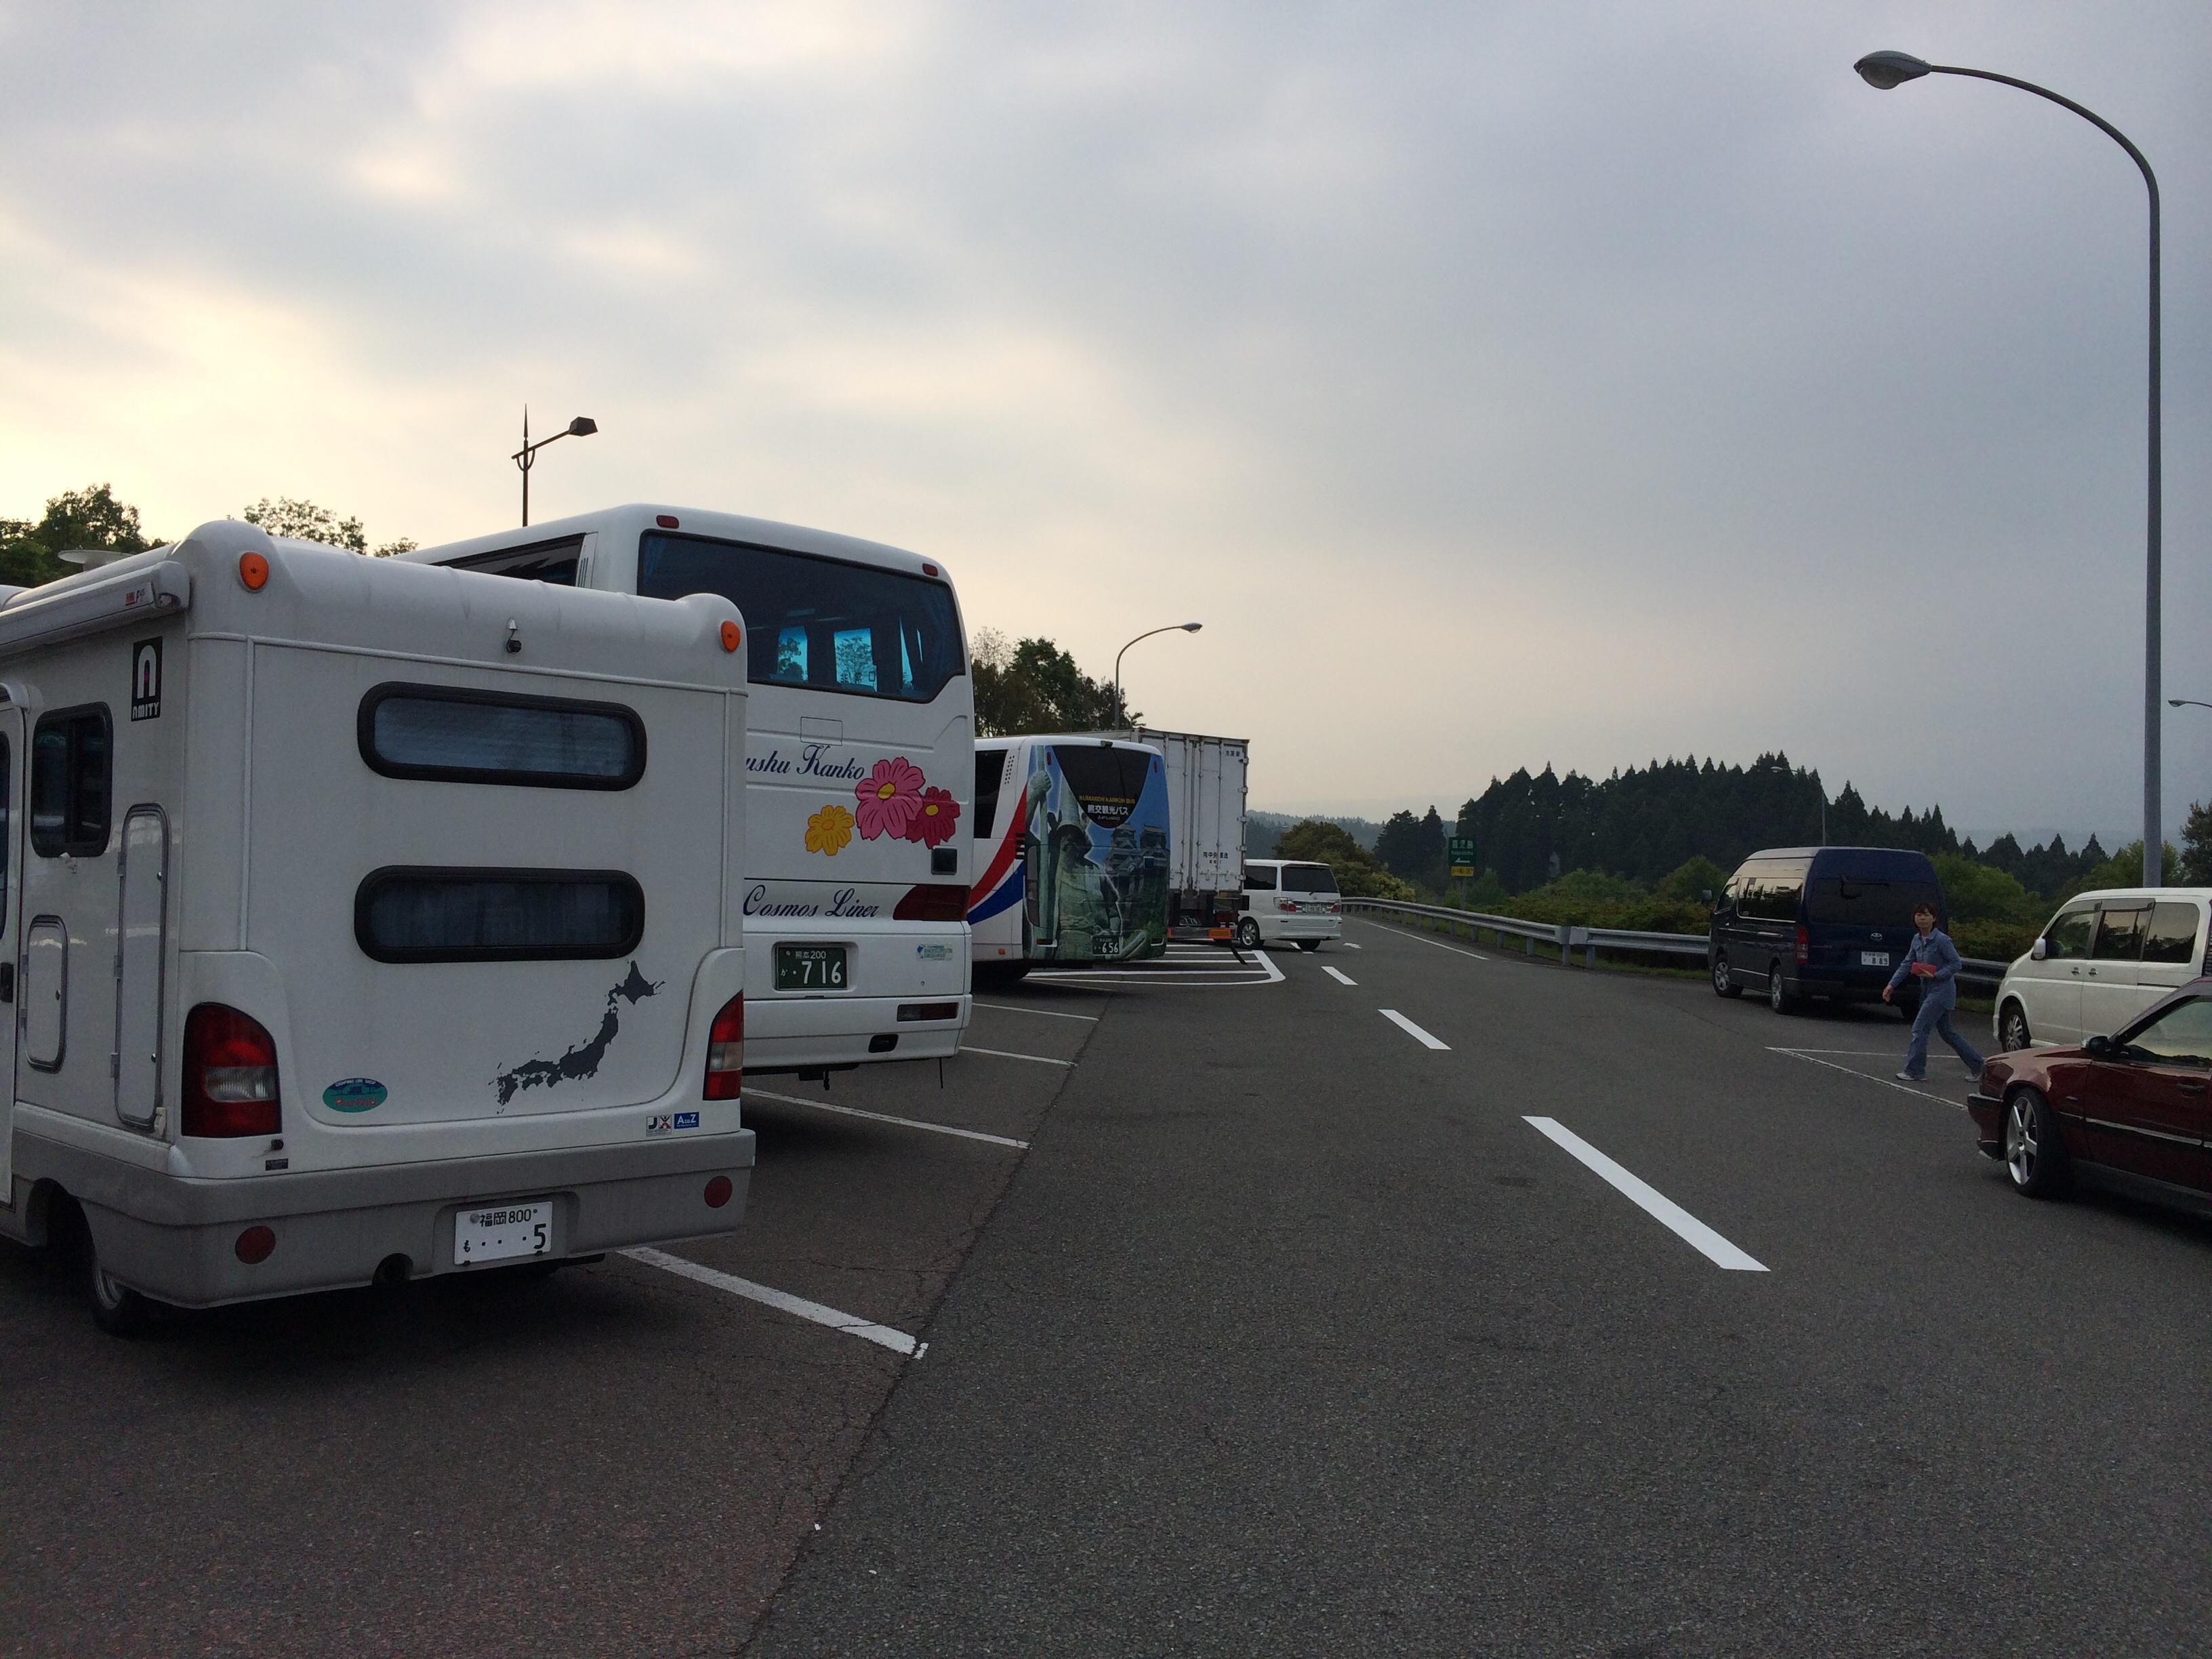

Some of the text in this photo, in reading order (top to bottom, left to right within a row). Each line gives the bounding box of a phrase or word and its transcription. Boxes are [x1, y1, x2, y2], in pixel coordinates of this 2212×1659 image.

[796, 744, 865, 780] Kanko
[1087, 804, 1129, 816] 熊交観光バス
[743, 884, 880, 918] Cosmos Liner
[1102, 942, 1118, 954] 656
[1872, 957, 1888, 965] 889
[802, 960, 842, 984] 716
